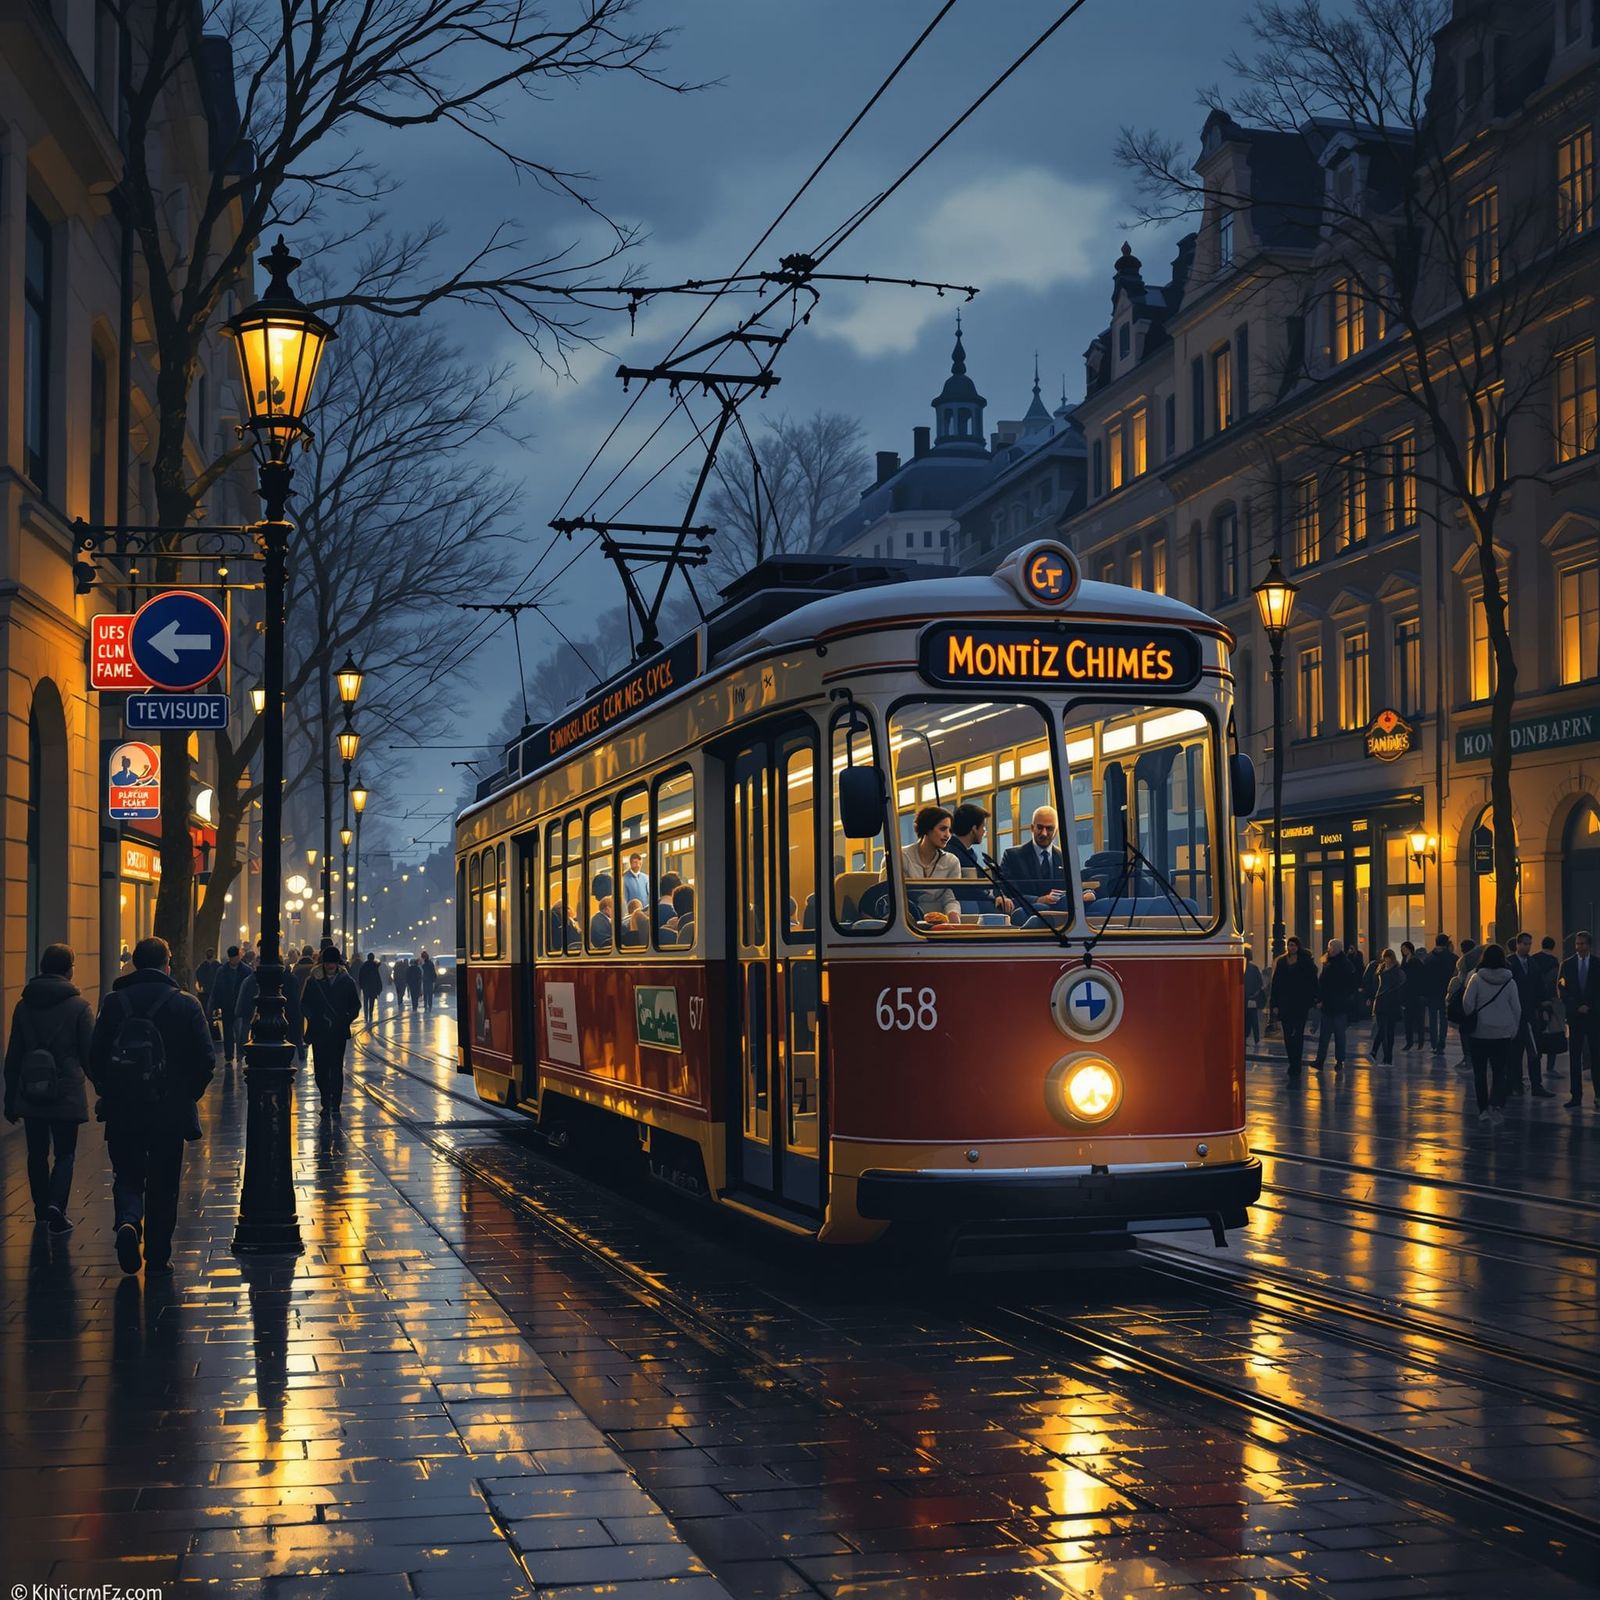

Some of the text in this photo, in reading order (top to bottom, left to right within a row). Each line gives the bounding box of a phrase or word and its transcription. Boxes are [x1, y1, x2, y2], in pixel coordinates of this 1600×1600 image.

[96, 663, 134, 678] FAME
[136, 702, 220, 719] TEVISUDE
[875, 986, 938, 1031] 658
